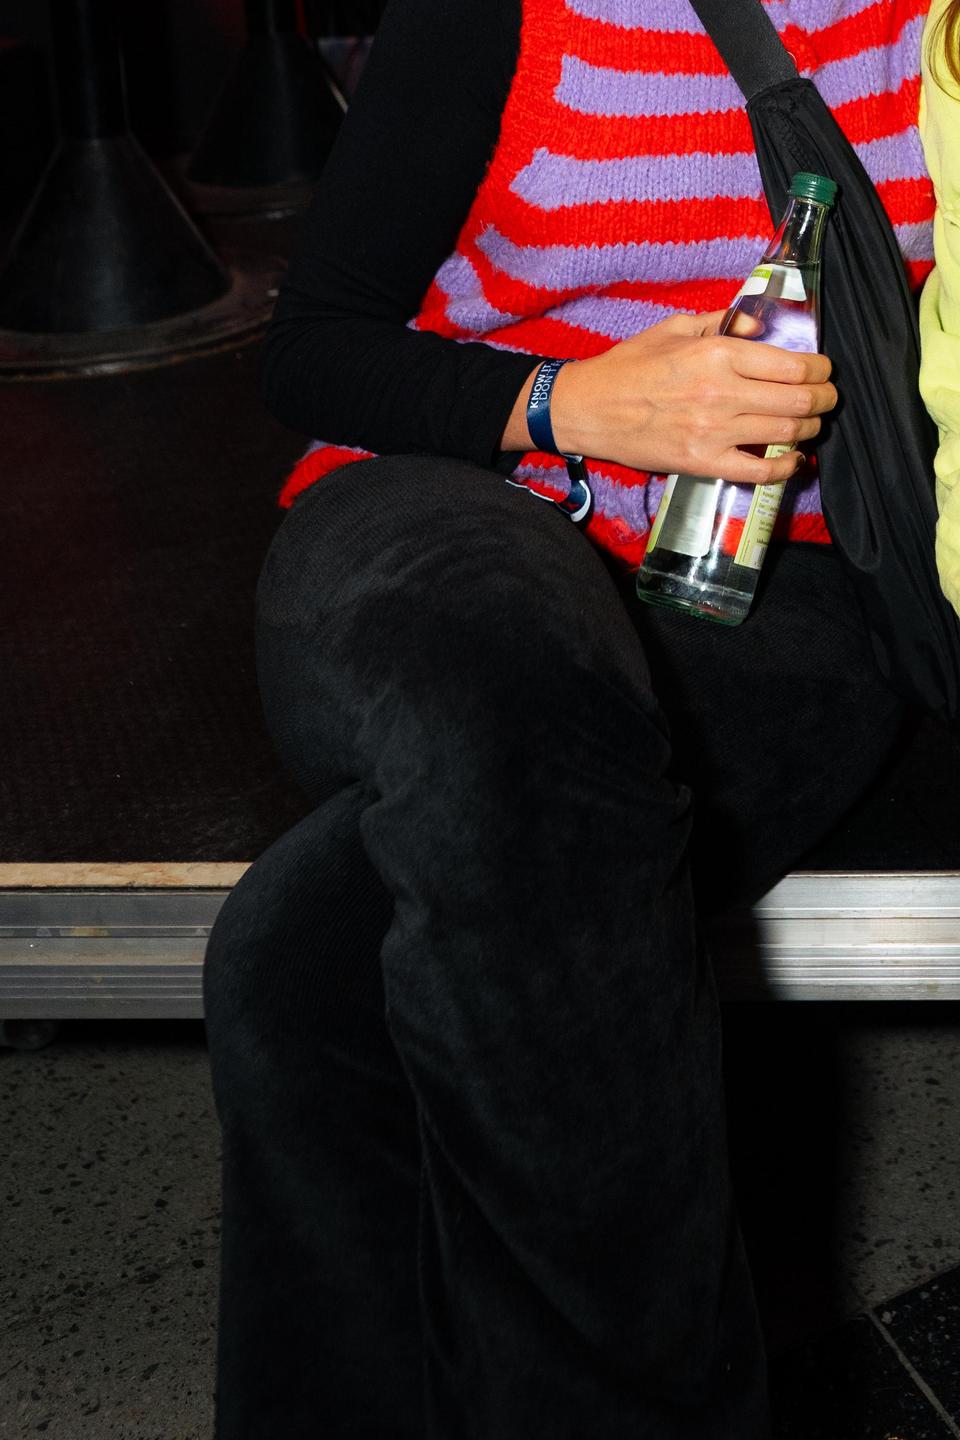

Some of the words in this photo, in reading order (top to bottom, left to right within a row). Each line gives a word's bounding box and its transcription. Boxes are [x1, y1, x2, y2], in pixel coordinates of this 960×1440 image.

[530, 373, 547, 409] KNOW
[541, 364, 552, 373] IT
[539, 367, 557, 400] DON'T
